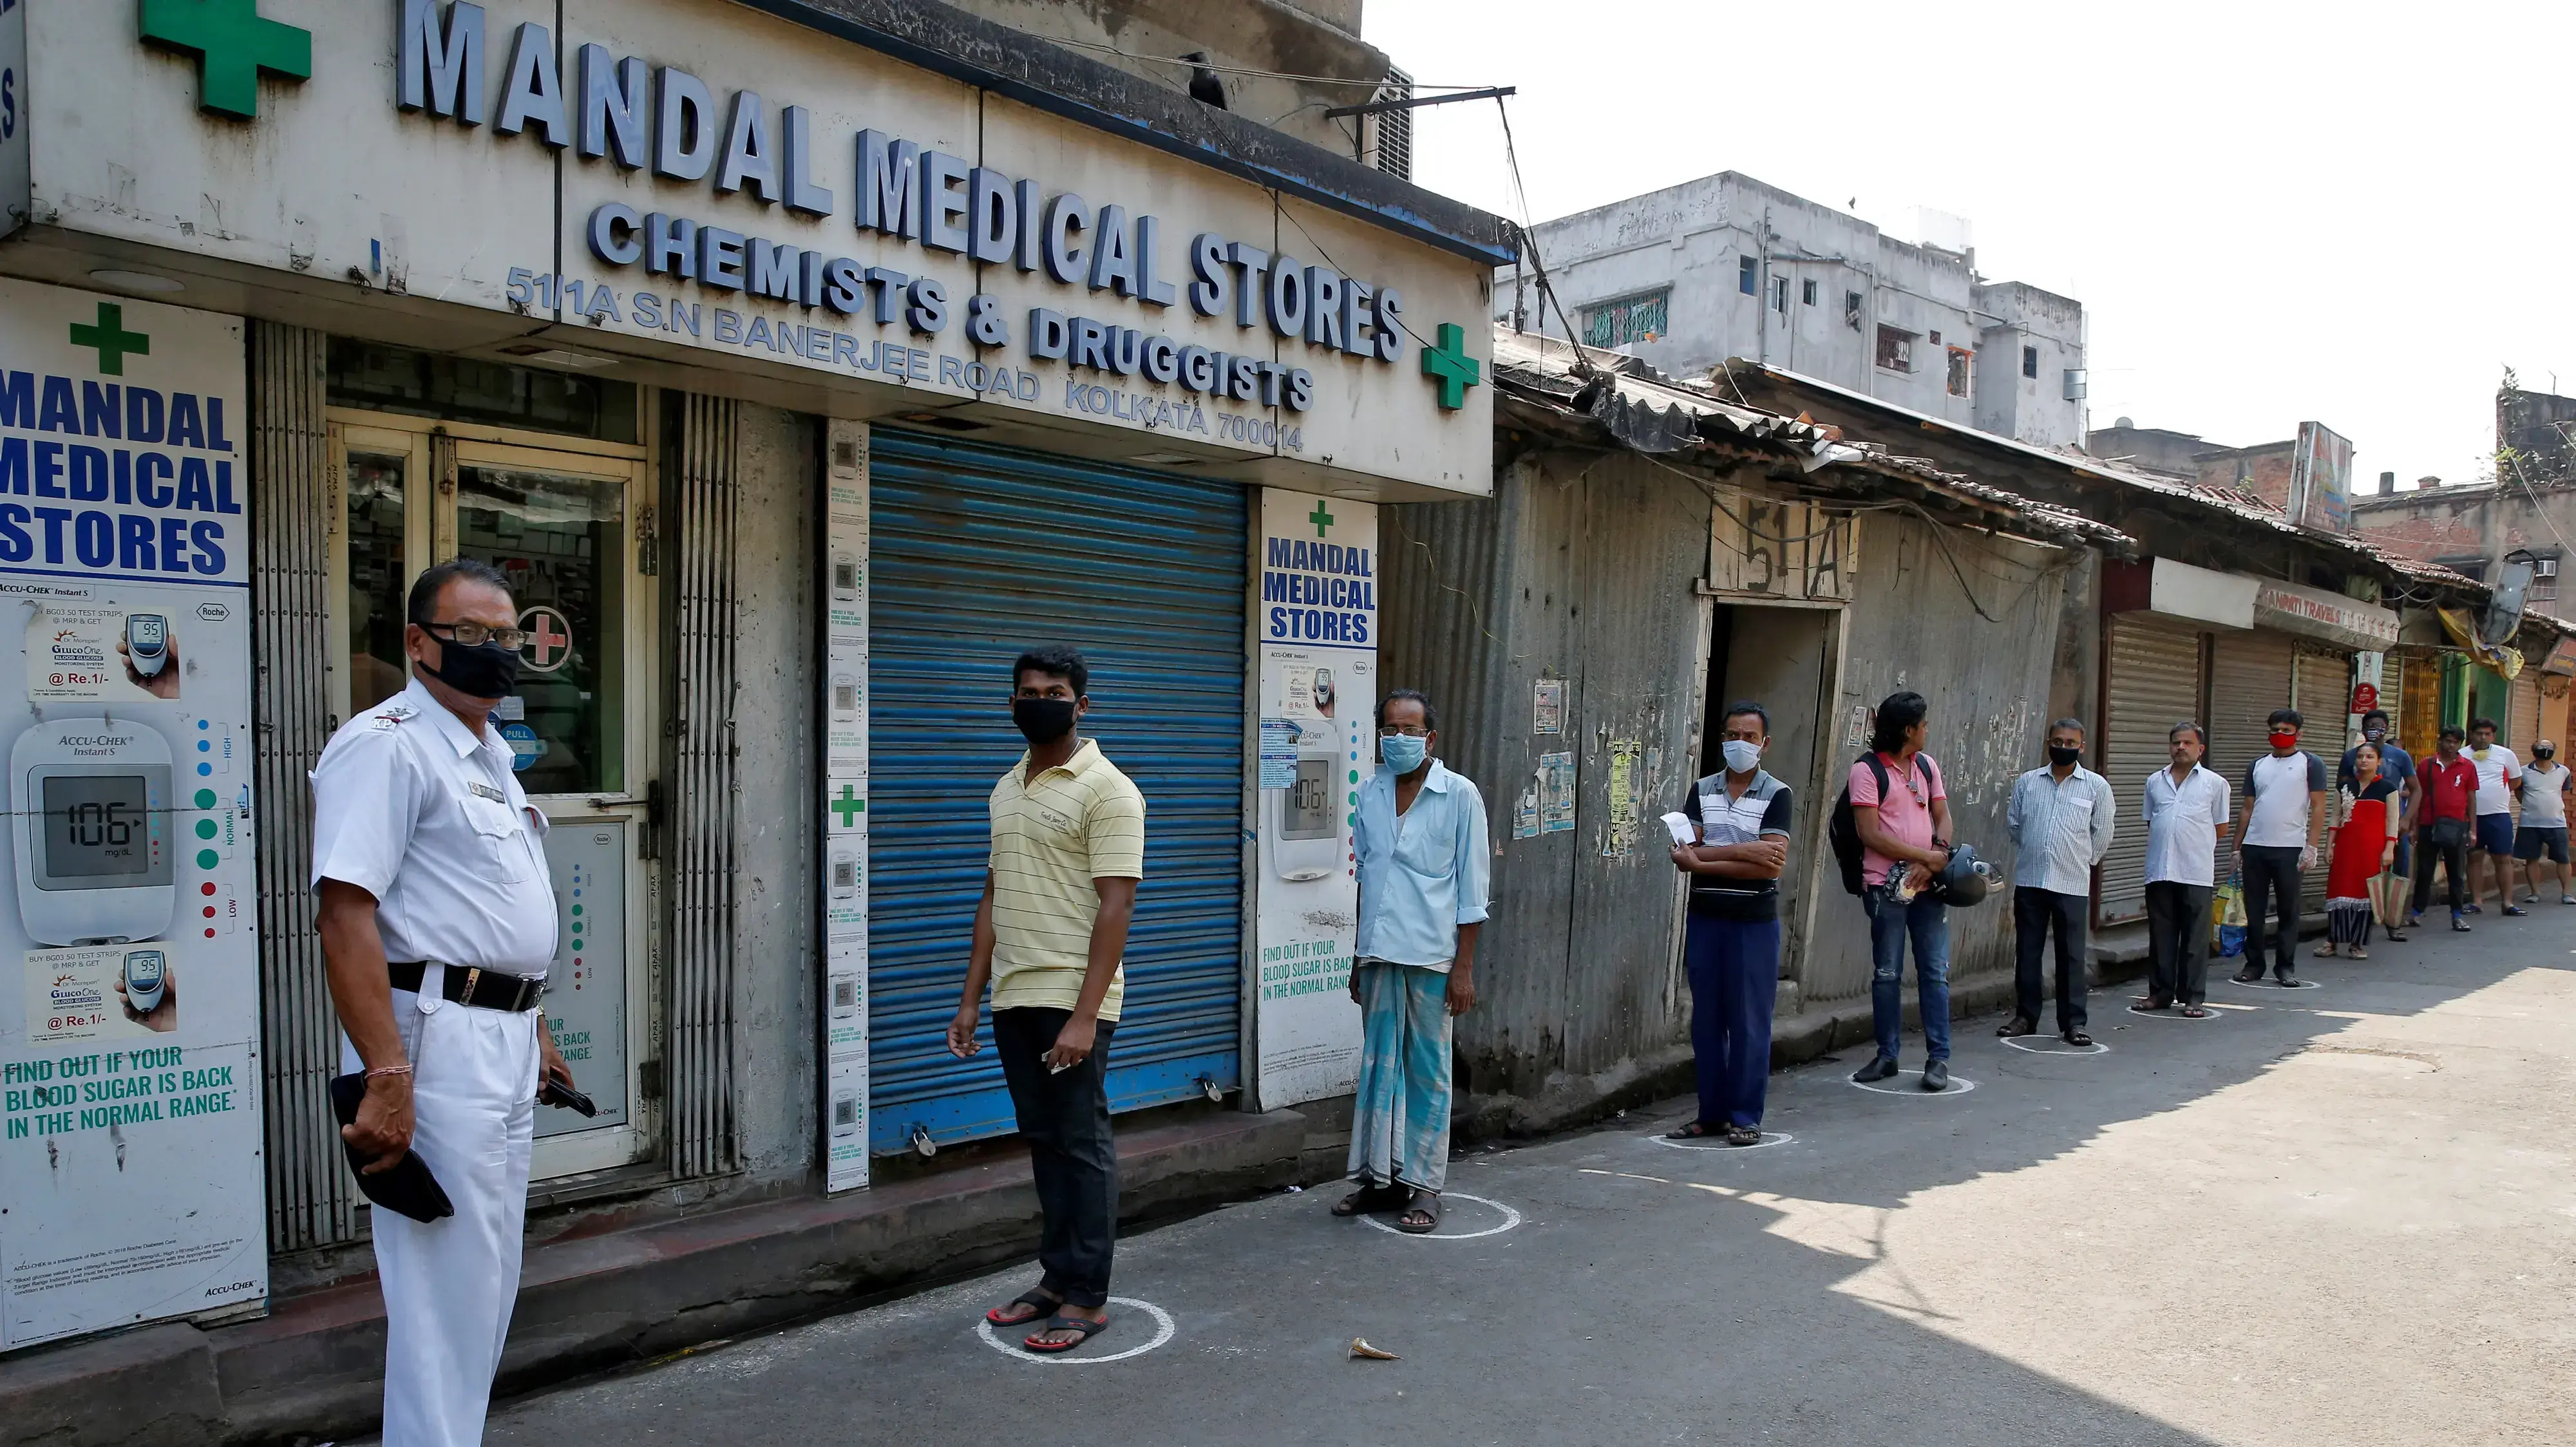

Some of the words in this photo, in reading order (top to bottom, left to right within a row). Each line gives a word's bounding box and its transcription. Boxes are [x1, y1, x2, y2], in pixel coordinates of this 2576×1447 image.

[397, 0, 833, 219] MANDAL
[857, 129, 1175, 308] MEDICAL
[1189, 232, 1405, 363] STORES
[587, 203, 947, 333] CHEMISTS
[966, 294, 1011, 348] &
[1030, 307, 1314, 412] DRUGGISTS
[632, 292, 701, 338] S.N
[714, 308, 931, 382] BANERJEE
[939, 354, 1041, 402] ROAD
[1066, 379, 1209, 435] KOLKATA
[1218, 411, 1304, 452] 700014
[0, 369, 233, 451] MANDAL
[0, 437, 241, 515] MEDICAL
[0, 503, 227, 575] STORES
[1747, 500, 1788, 592] 51
[1268, 537, 1372, 577] MANDAL
[55, 588, 82, 596] Instant
[1264, 571, 1375, 610] MEDICAL
[202, 607, 225, 617] Roche
[1271, 607, 1368, 643] STORES
[2304, 600, 2340, 623] TRAVELS
[144, 623, 158, 635] 95
[49, 673, 64, 686] @
[68, 673, 109, 684] Re.1/-
[74, 747, 109, 756] Instant
[109, 748, 115, 756] S
[223, 737, 232, 759] HIGH
[1294, 779, 1321, 810] 106
[69, 802, 130, 846] 106
[226, 809, 234, 846] NORMAL
[105, 848, 133, 857] mg/dL
[1264, 945, 1281, 963] FIND
[1284, 943, 1300, 960] OUT
[1302, 941, 1309, 957] IF
[1312, 940, 1335, 956] YOUR
[141, 960, 156, 972] 95
[1264, 964, 1289, 982] BLOOD
[1292, 961, 1320, 978] SUGAR
[1323, 959, 1331, 973] IS
[1334, 956, 1353, 971] BAC
[1264, 985, 1271, 1001] IN
[1274, 983, 1289, 999] THE
[1291, 978, 1325, 996] NORMAL
[48, 1017, 62, 1030] @
[66, 1014, 106, 1026] Re.1/-
[564, 1032, 591, 1046] BACK
[5, 1059, 53, 1085] FIND
[60, 1054, 100, 1080] OUT
[107, 1052, 123, 1073] IF
[129, 1046, 183, 1071] YOUR
[6, 1085, 77, 1112] BLOOD
[84, 1076, 152, 1102] SUGAR
[158, 1073, 176, 1093] IS
[182, 1066, 233, 1091] BACK
[7, 1116, 29, 1139] IN
[35, 1111, 74, 1135] THE
[80, 1101, 164, 1130] NORMAL
[14, 1262, 47, 1272] ACCU-CHEK
[57, 1255, 83, 1264] trademark
[14, 1287, 38, 1296] condition
